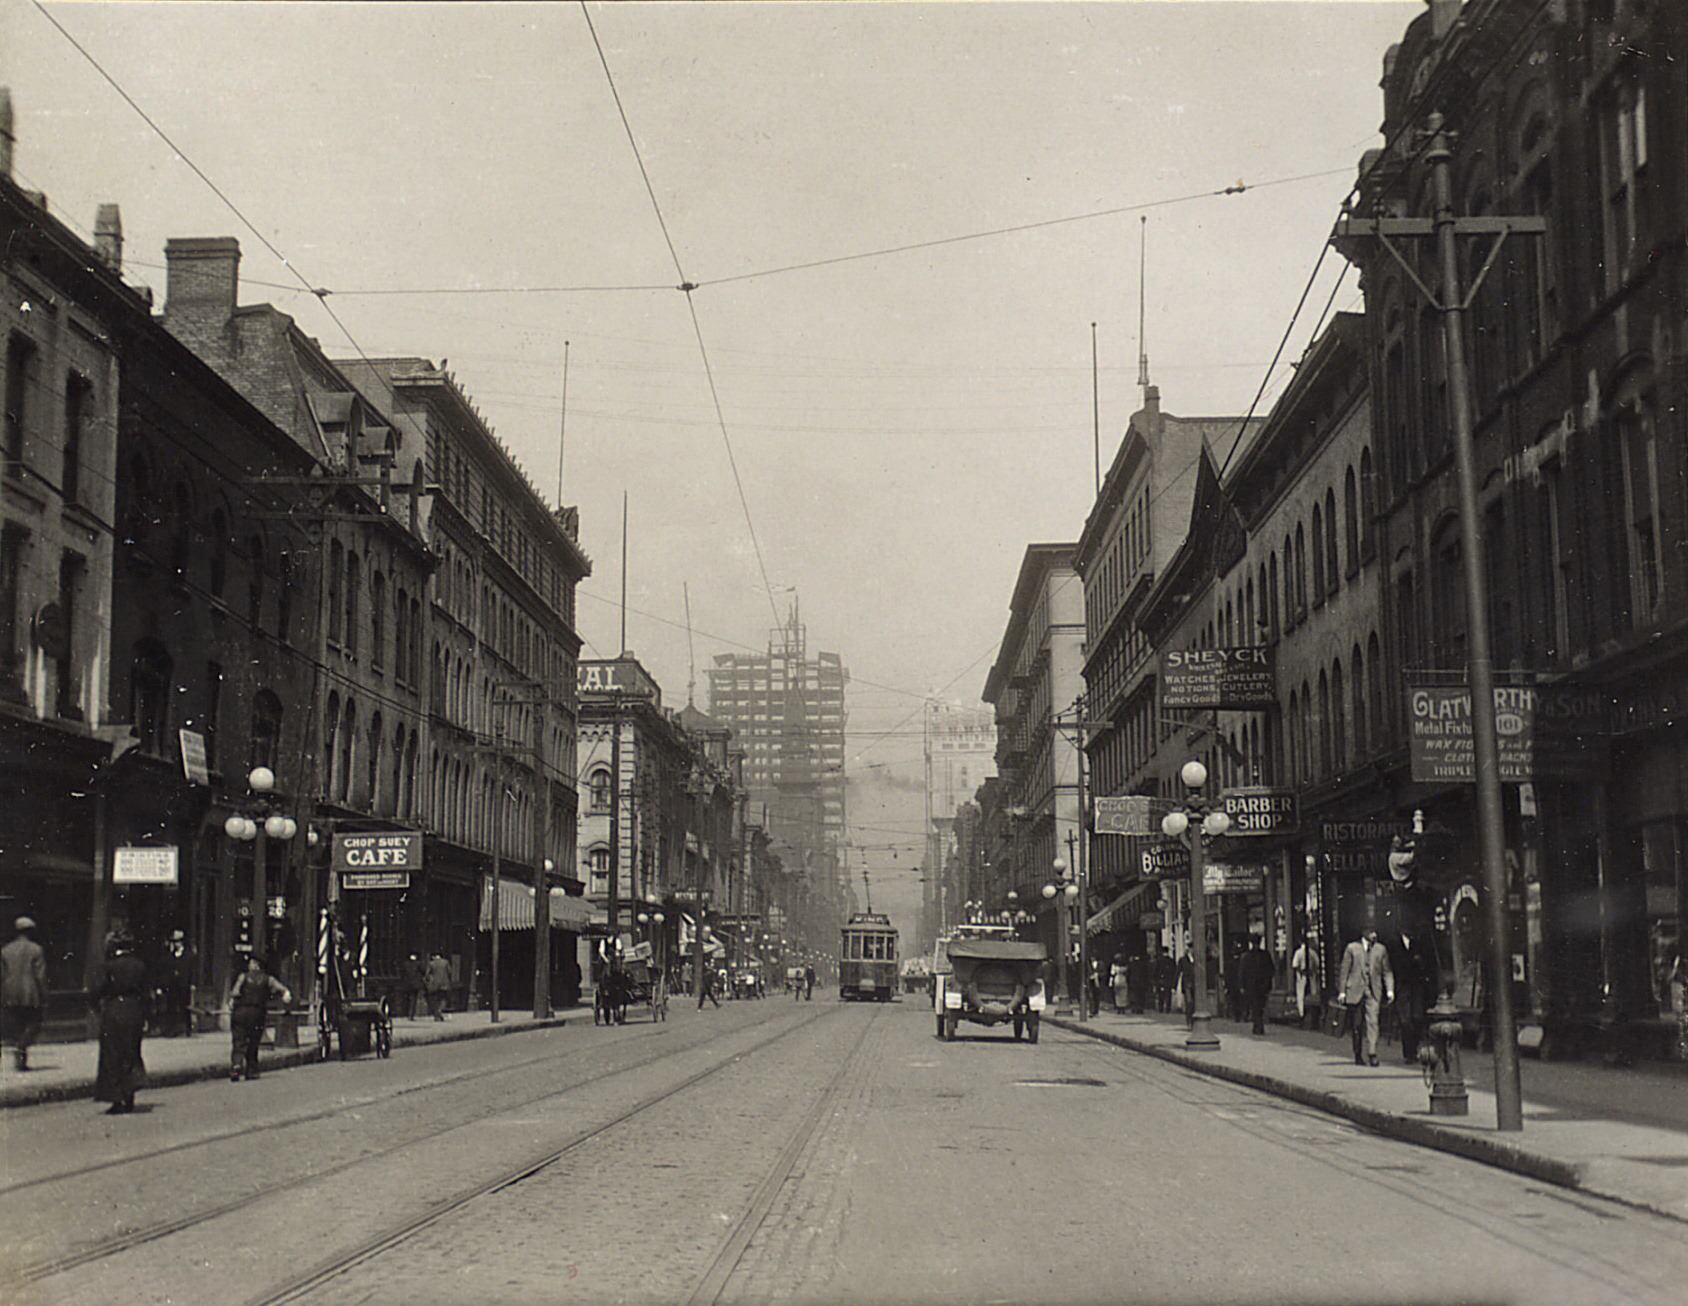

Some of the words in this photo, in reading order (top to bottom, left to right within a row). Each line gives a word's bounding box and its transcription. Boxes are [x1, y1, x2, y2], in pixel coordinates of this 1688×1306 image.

[1167, 648, 1268, 668] SHEYCK
[577, 666, 623, 690] AL
[1414, 720, 1443, 736] Metal
[1445, 720, 1473, 736] Fixtu
[1225, 797, 1292, 814] BARBER
[1237, 813, 1283, 830] SHOP
[343, 837, 375, 848] CHOP
[377, 836, 411, 848] SUEY
[346, 848, 407, 866] CAFE
